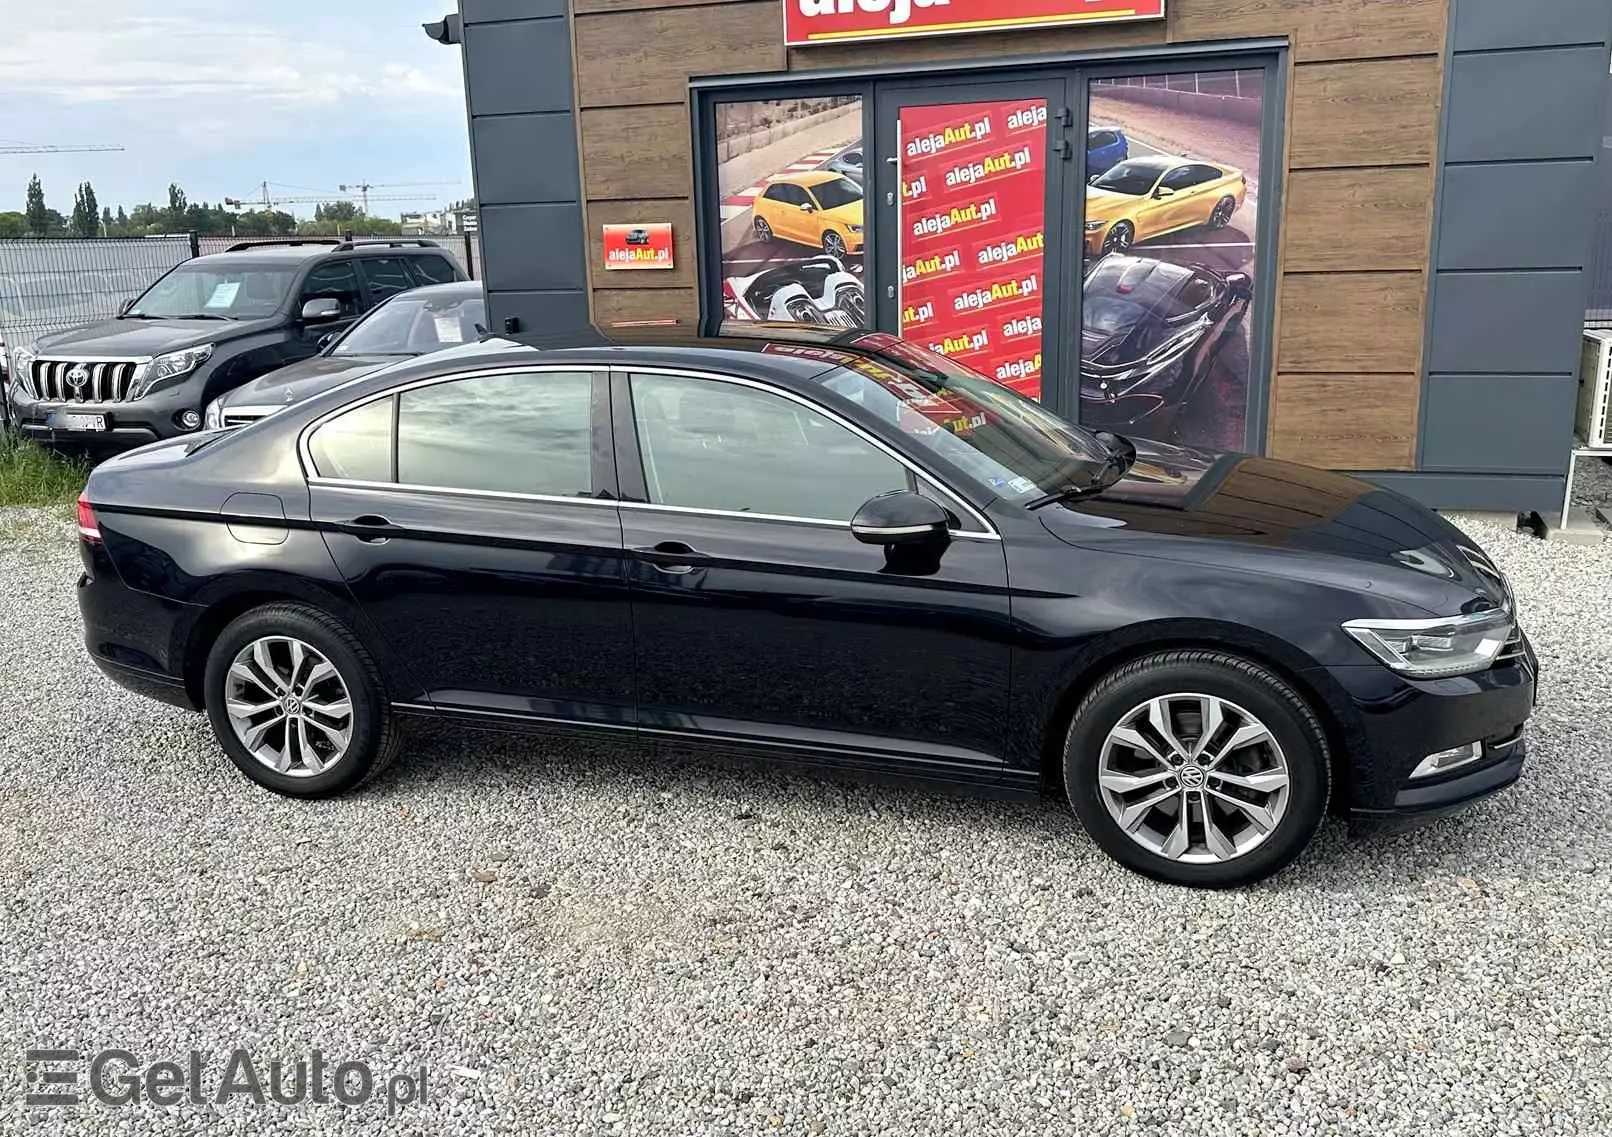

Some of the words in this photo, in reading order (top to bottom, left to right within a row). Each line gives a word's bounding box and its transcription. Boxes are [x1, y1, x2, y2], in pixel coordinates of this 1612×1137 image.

[1007, 106, 1047, 130] aleja
[906, 117, 991, 157] alejaAut.pl
[945, 147, 1031, 186] alejaAut.pl
[913, 199, 997, 236] alejaAut.pl
[609, 249, 668, 263] alejaAut.pl
[977, 232, 1044, 264] alejaAut
[953, 275, 1038, 310] alejaAut.pl
[1003, 316, 1042, 337] aleja
